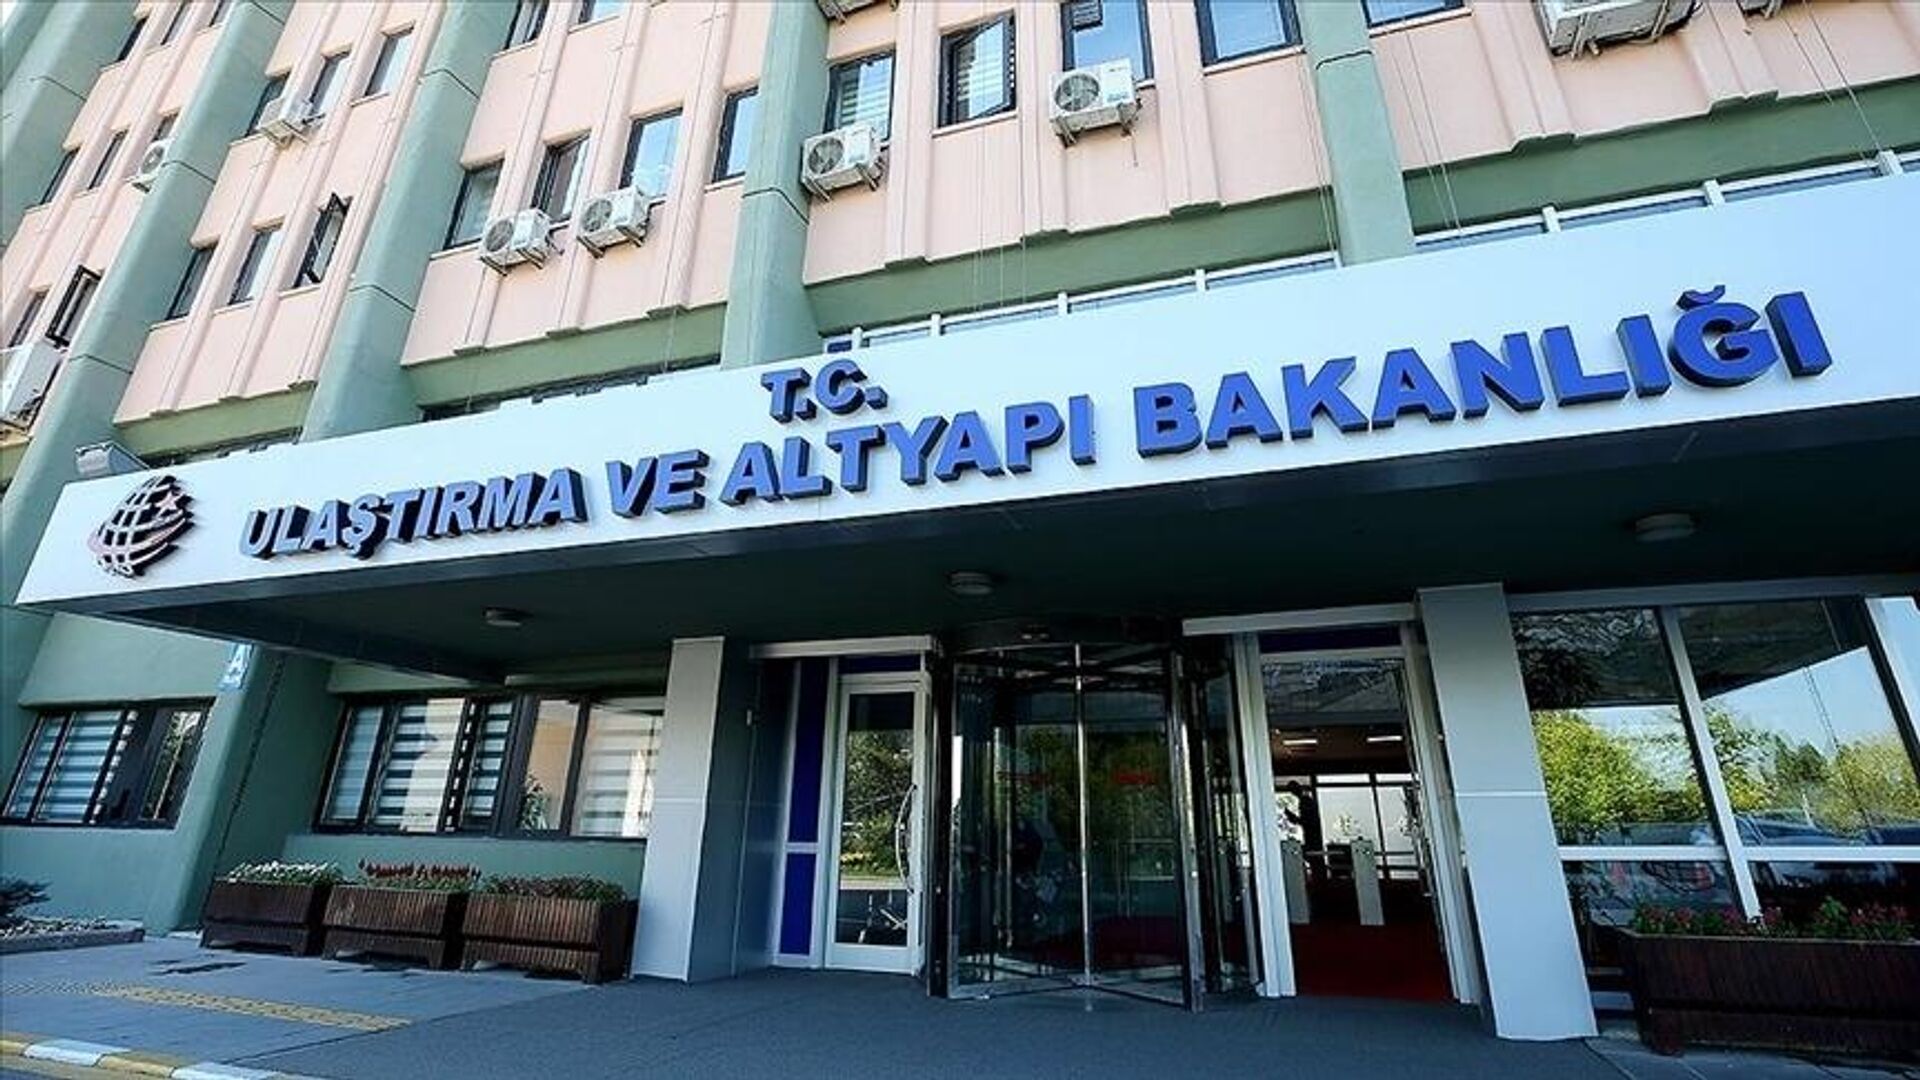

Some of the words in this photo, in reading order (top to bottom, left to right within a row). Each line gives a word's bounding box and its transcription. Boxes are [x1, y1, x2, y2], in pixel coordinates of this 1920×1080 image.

[239, 468, 587, 559] ULAŞTIRMA
[606, 448, 709, 518] VE
[720, 394, 1096, 505] ALTYAPI
[1133, 285, 1832, 458] BAKANLIĞI
[761, 358, 888, 423] T.C.
